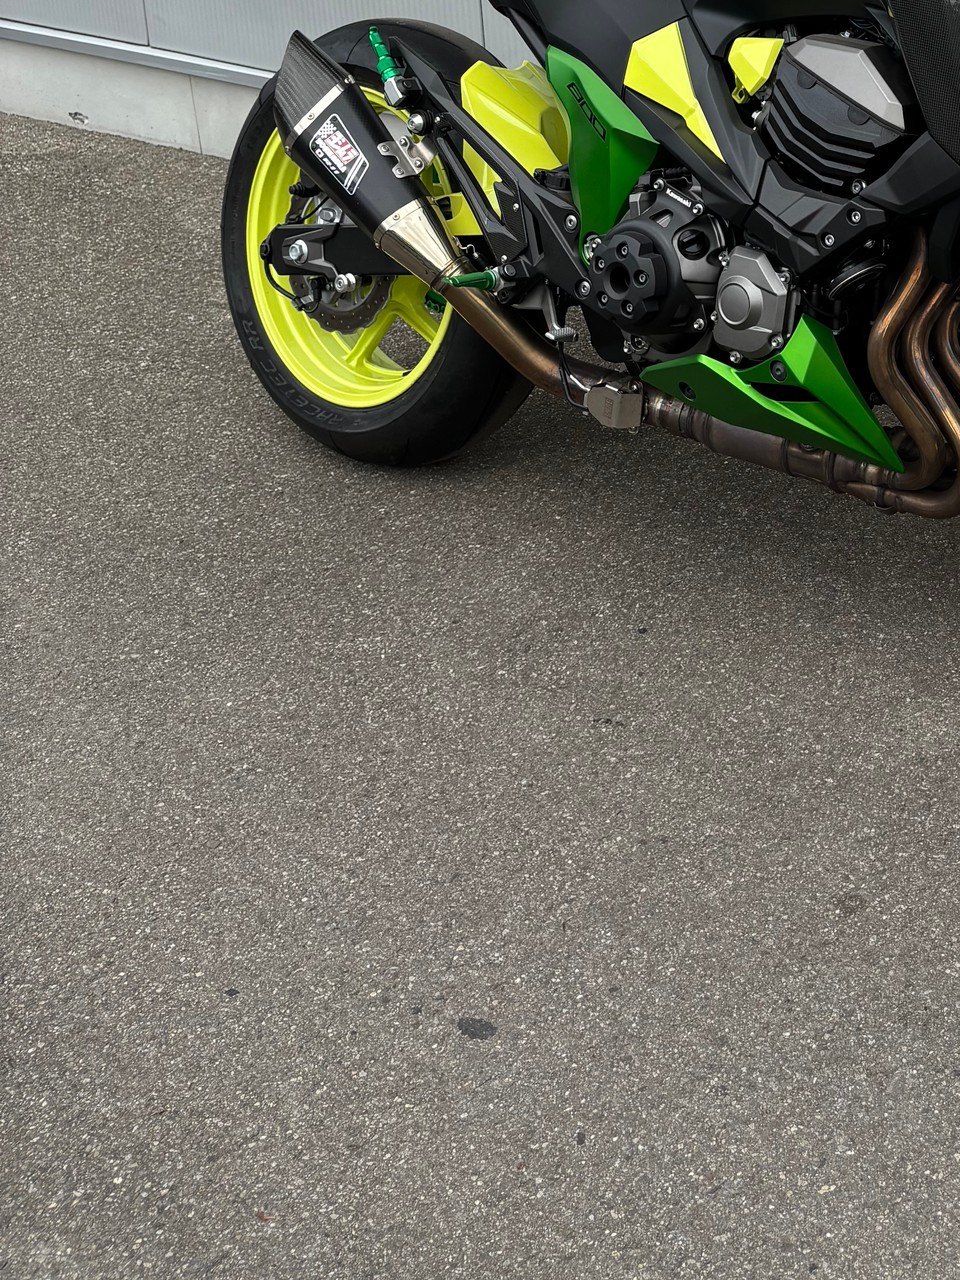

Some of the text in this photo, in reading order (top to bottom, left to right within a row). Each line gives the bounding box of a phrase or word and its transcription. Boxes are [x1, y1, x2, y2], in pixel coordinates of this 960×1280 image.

[566, 82, 607, 141] 800
[665, 187, 692, 208] Kawasaki
[259, 359, 344, 425] RACETEC
